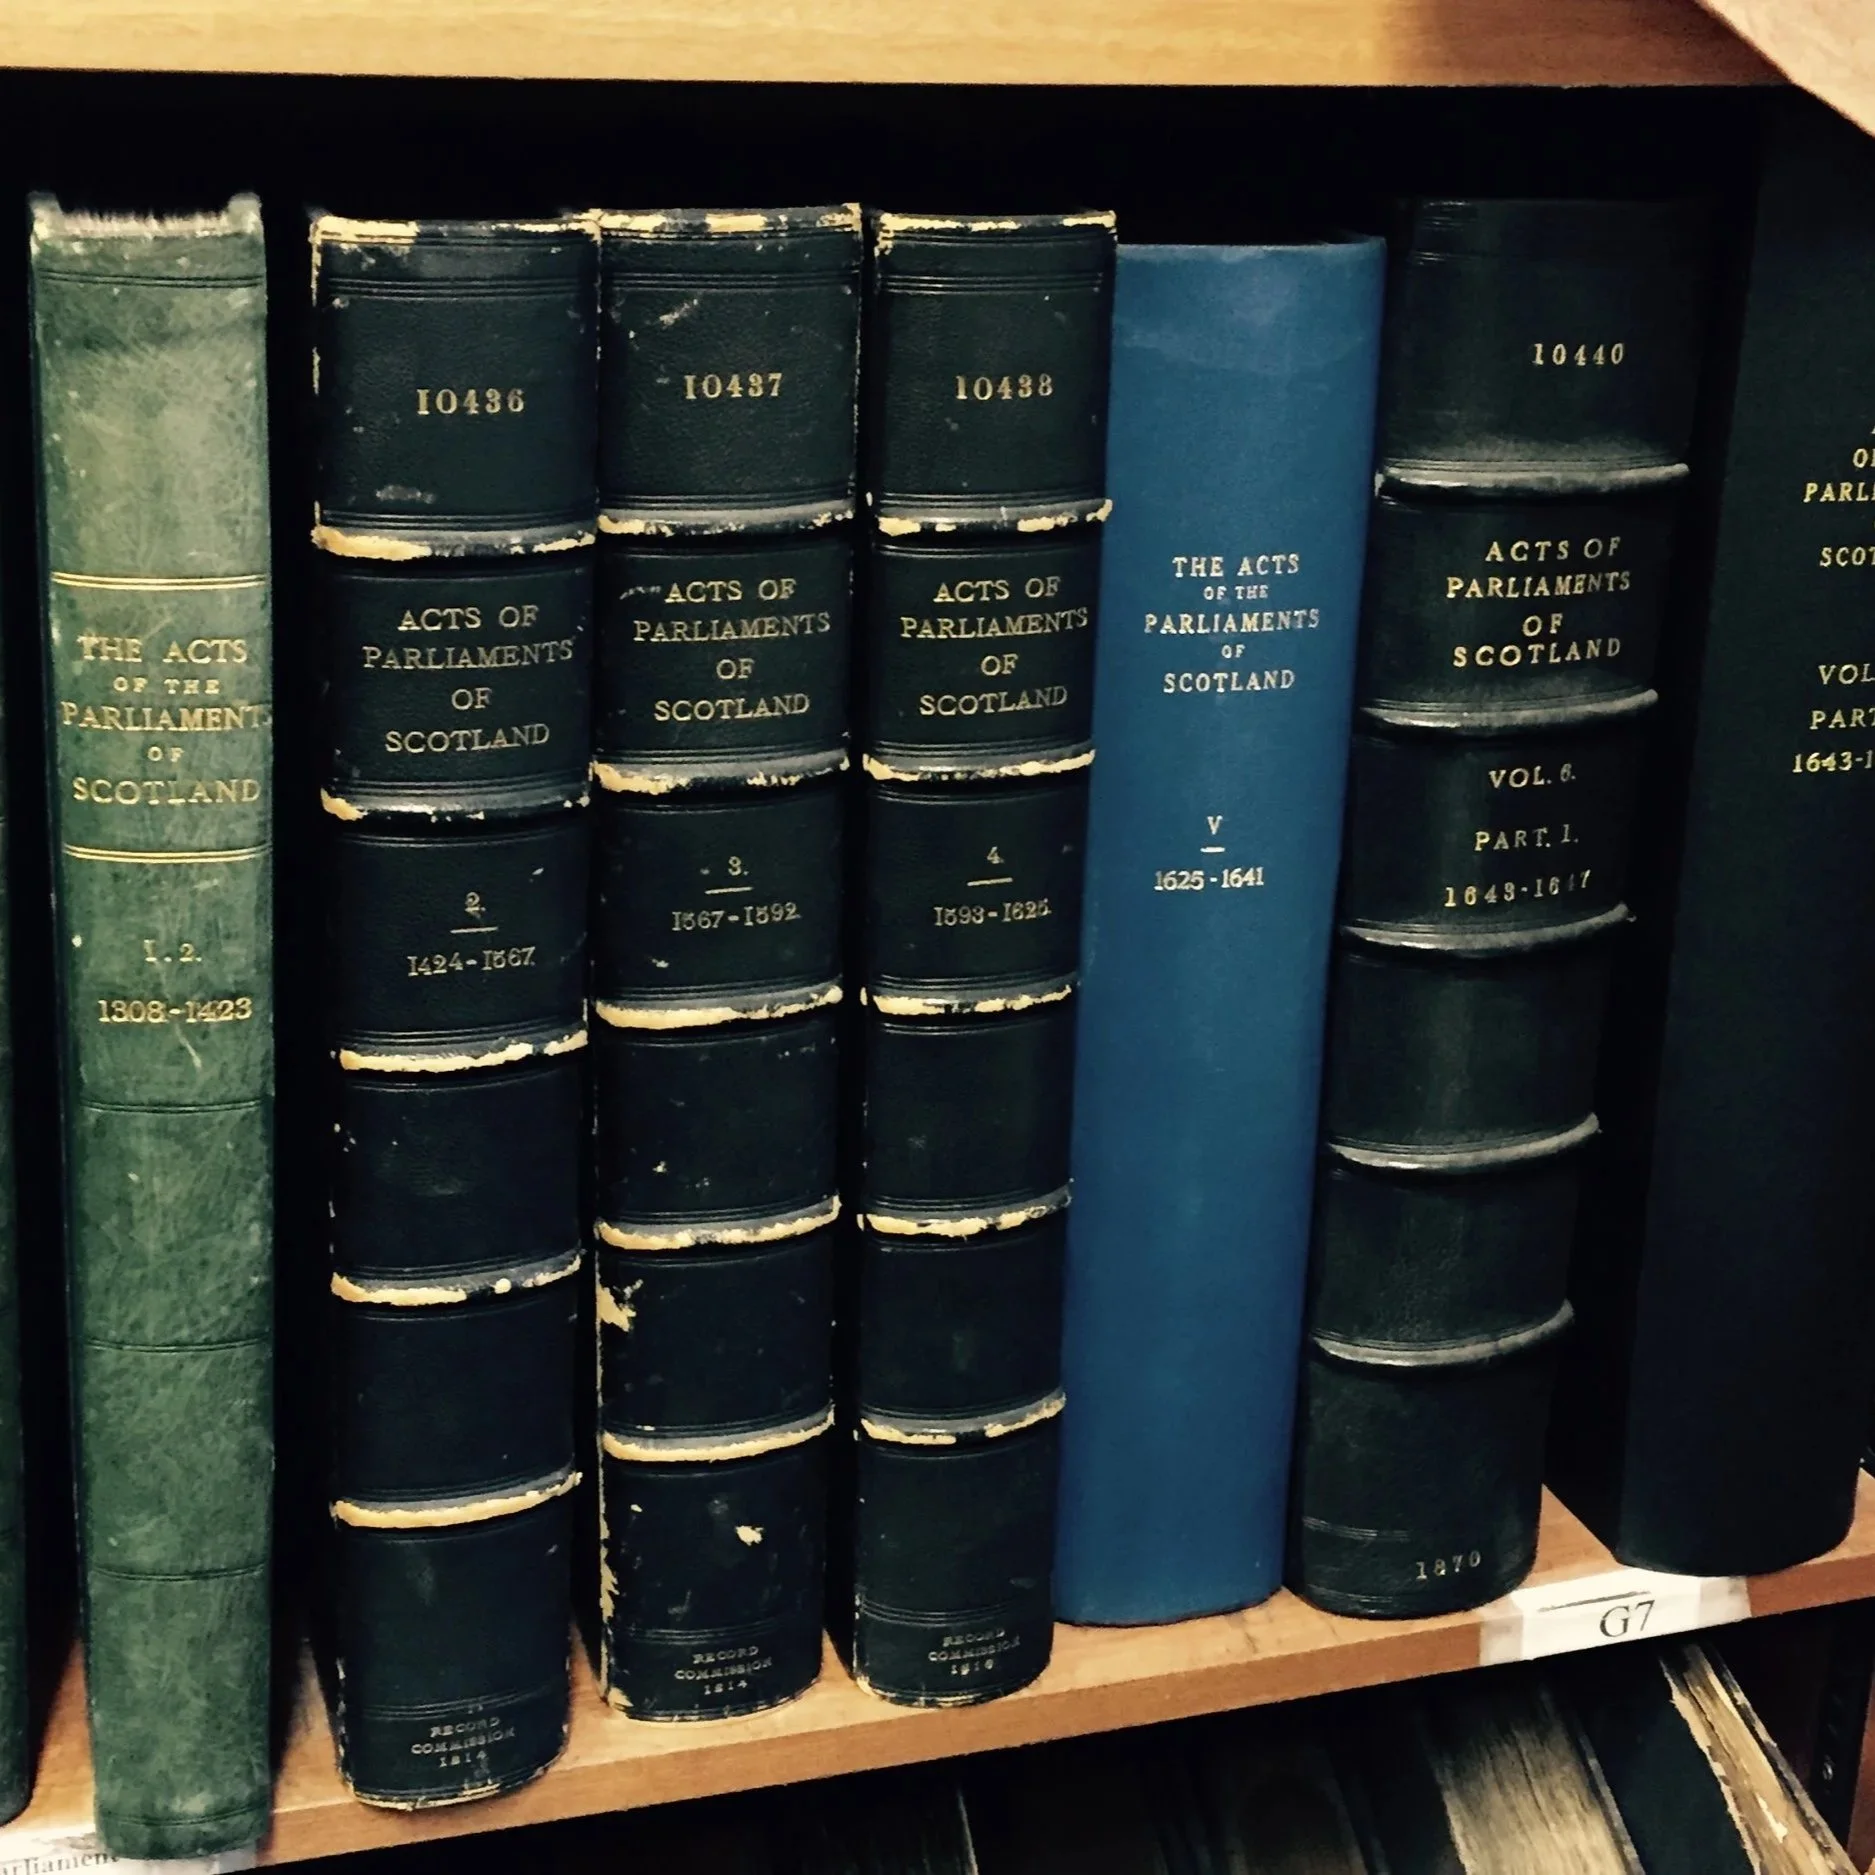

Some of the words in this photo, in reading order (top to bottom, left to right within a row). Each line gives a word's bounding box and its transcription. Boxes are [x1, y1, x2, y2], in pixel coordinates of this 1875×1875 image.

[1532, 343, 1625, 366] 10440
[684, 371, 783, 400] 10437
[955, 373, 1054, 401] 10438
[416, 387, 526, 416] 10436
[1485, 540, 1570, 562] ACTS
[1583, 536, 1621, 559] OF
[1172, 556, 1224, 578] THE
[1237, 553, 1300, 577] ACTS
[664, 580, 743, 603] ACTS
[758, 578, 797, 601] OF
[933, 578, 1010, 602] ACTS
[1025, 576, 1062, 599] OF
[1203, 585, 1227, 600] OF
[1234, 584, 1269, 600] THE
[1445, 571, 1631, 599] PARLIAMENTS
[397, 607, 482, 632] ACTS
[499, 604, 540, 629] OF
[633, 611, 831, 642] PARLIAMENTS
[900, 606, 1089, 640] PARLIAMENTS
[1144, 608, 1320, 634] PARLIAMENTS
[1522, 613, 1563, 637] OF
[76, 635, 142, 664] THE
[163, 638, 249, 665] ACTS
[362, 640, 574, 670] PARLIAMENTS
[1221, 644, 1245, 659] OF
[1452, 638, 1621, 668] SCOTLAND
[716, 658, 755, 680] OF
[980, 653, 1019, 676] OF
[113, 676, 148, 694] OF
[164, 678, 221, 696] THE
[1163, 669, 1295, 693] SCOTLAND
[451, 687, 493, 711] OF
[654, 692, 811, 722] SCOTLAND
[919, 686, 1068, 716] SCOTLAND
[385, 723, 551, 755] SCOTLAND
[147, 746, 185, 763] OF
[1489, 765, 1553, 789] VOL.
[1559, 763, 1577, 783] 6.
[73, 778, 261, 805] SCOTLAND
[1207, 815, 1223, 835] V
[1474, 827, 1551, 851] PART.
[98, 997, 253, 1024] 1308-1423
[1415, 1550, 1482, 1580] 1870
[1599, 1600, 1656, 1638] G7
